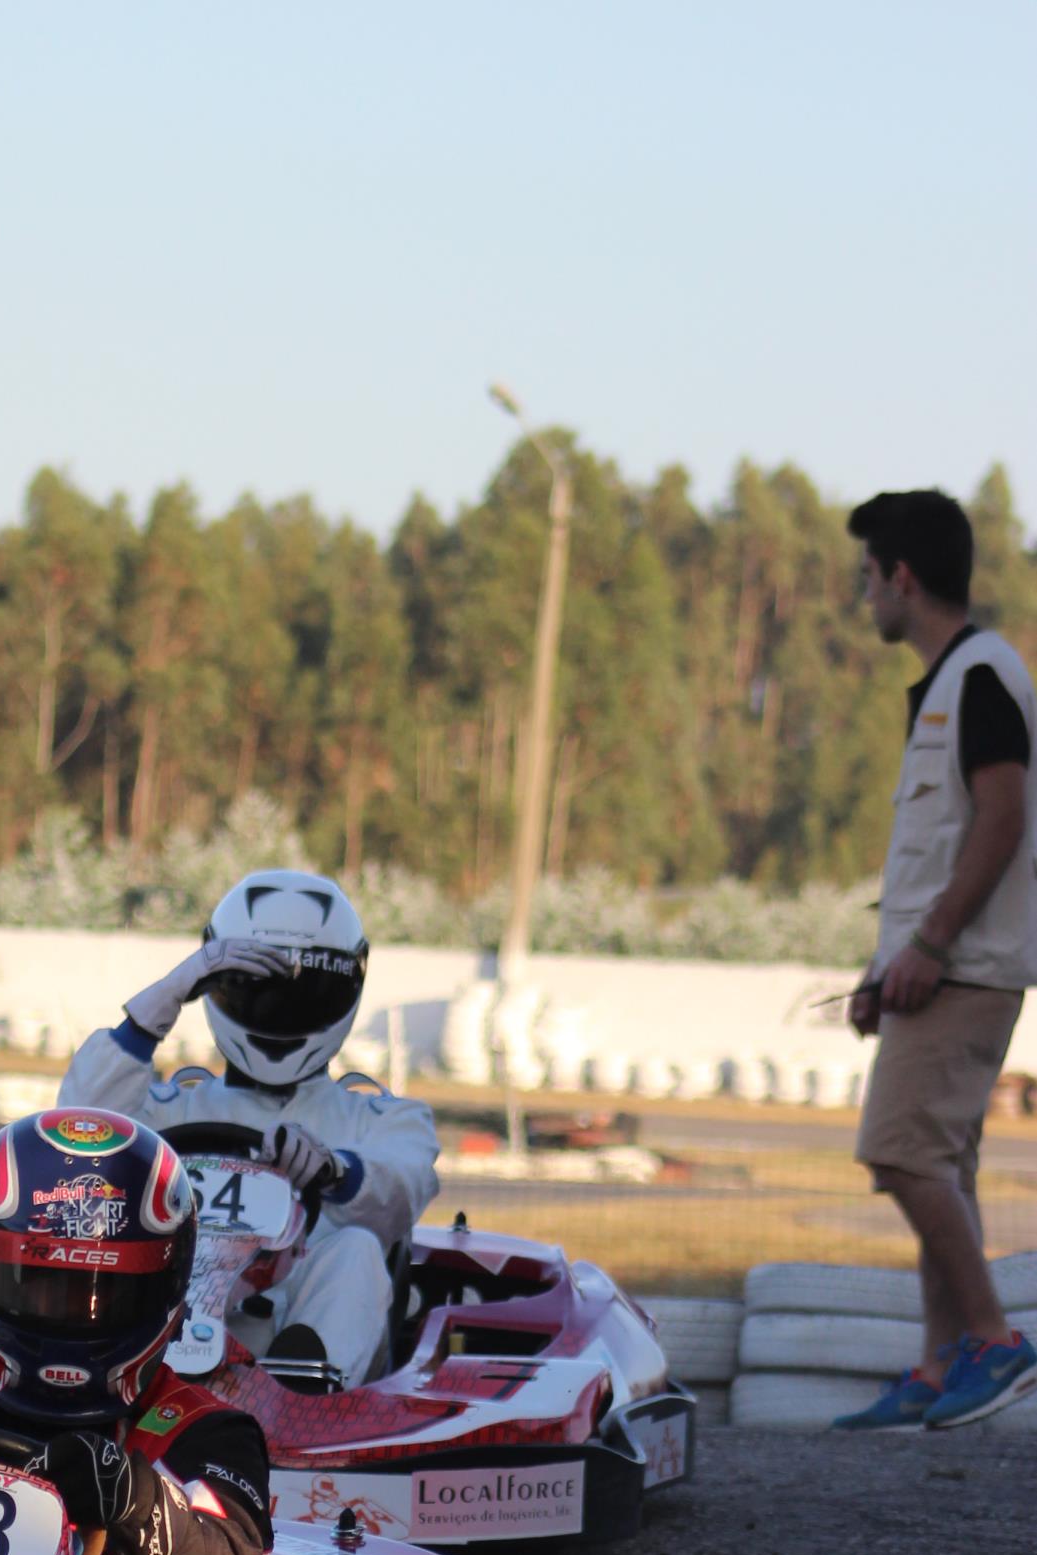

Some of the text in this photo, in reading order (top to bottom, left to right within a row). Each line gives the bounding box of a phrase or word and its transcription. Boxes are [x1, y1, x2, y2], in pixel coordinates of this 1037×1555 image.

[33, 1185, 85, 1206] Red Bull
[79, 1199, 126, 1219] KART
[66, 1218, 119, 1238] FIGHT
[45, 1369, 85, 1382] BELL
